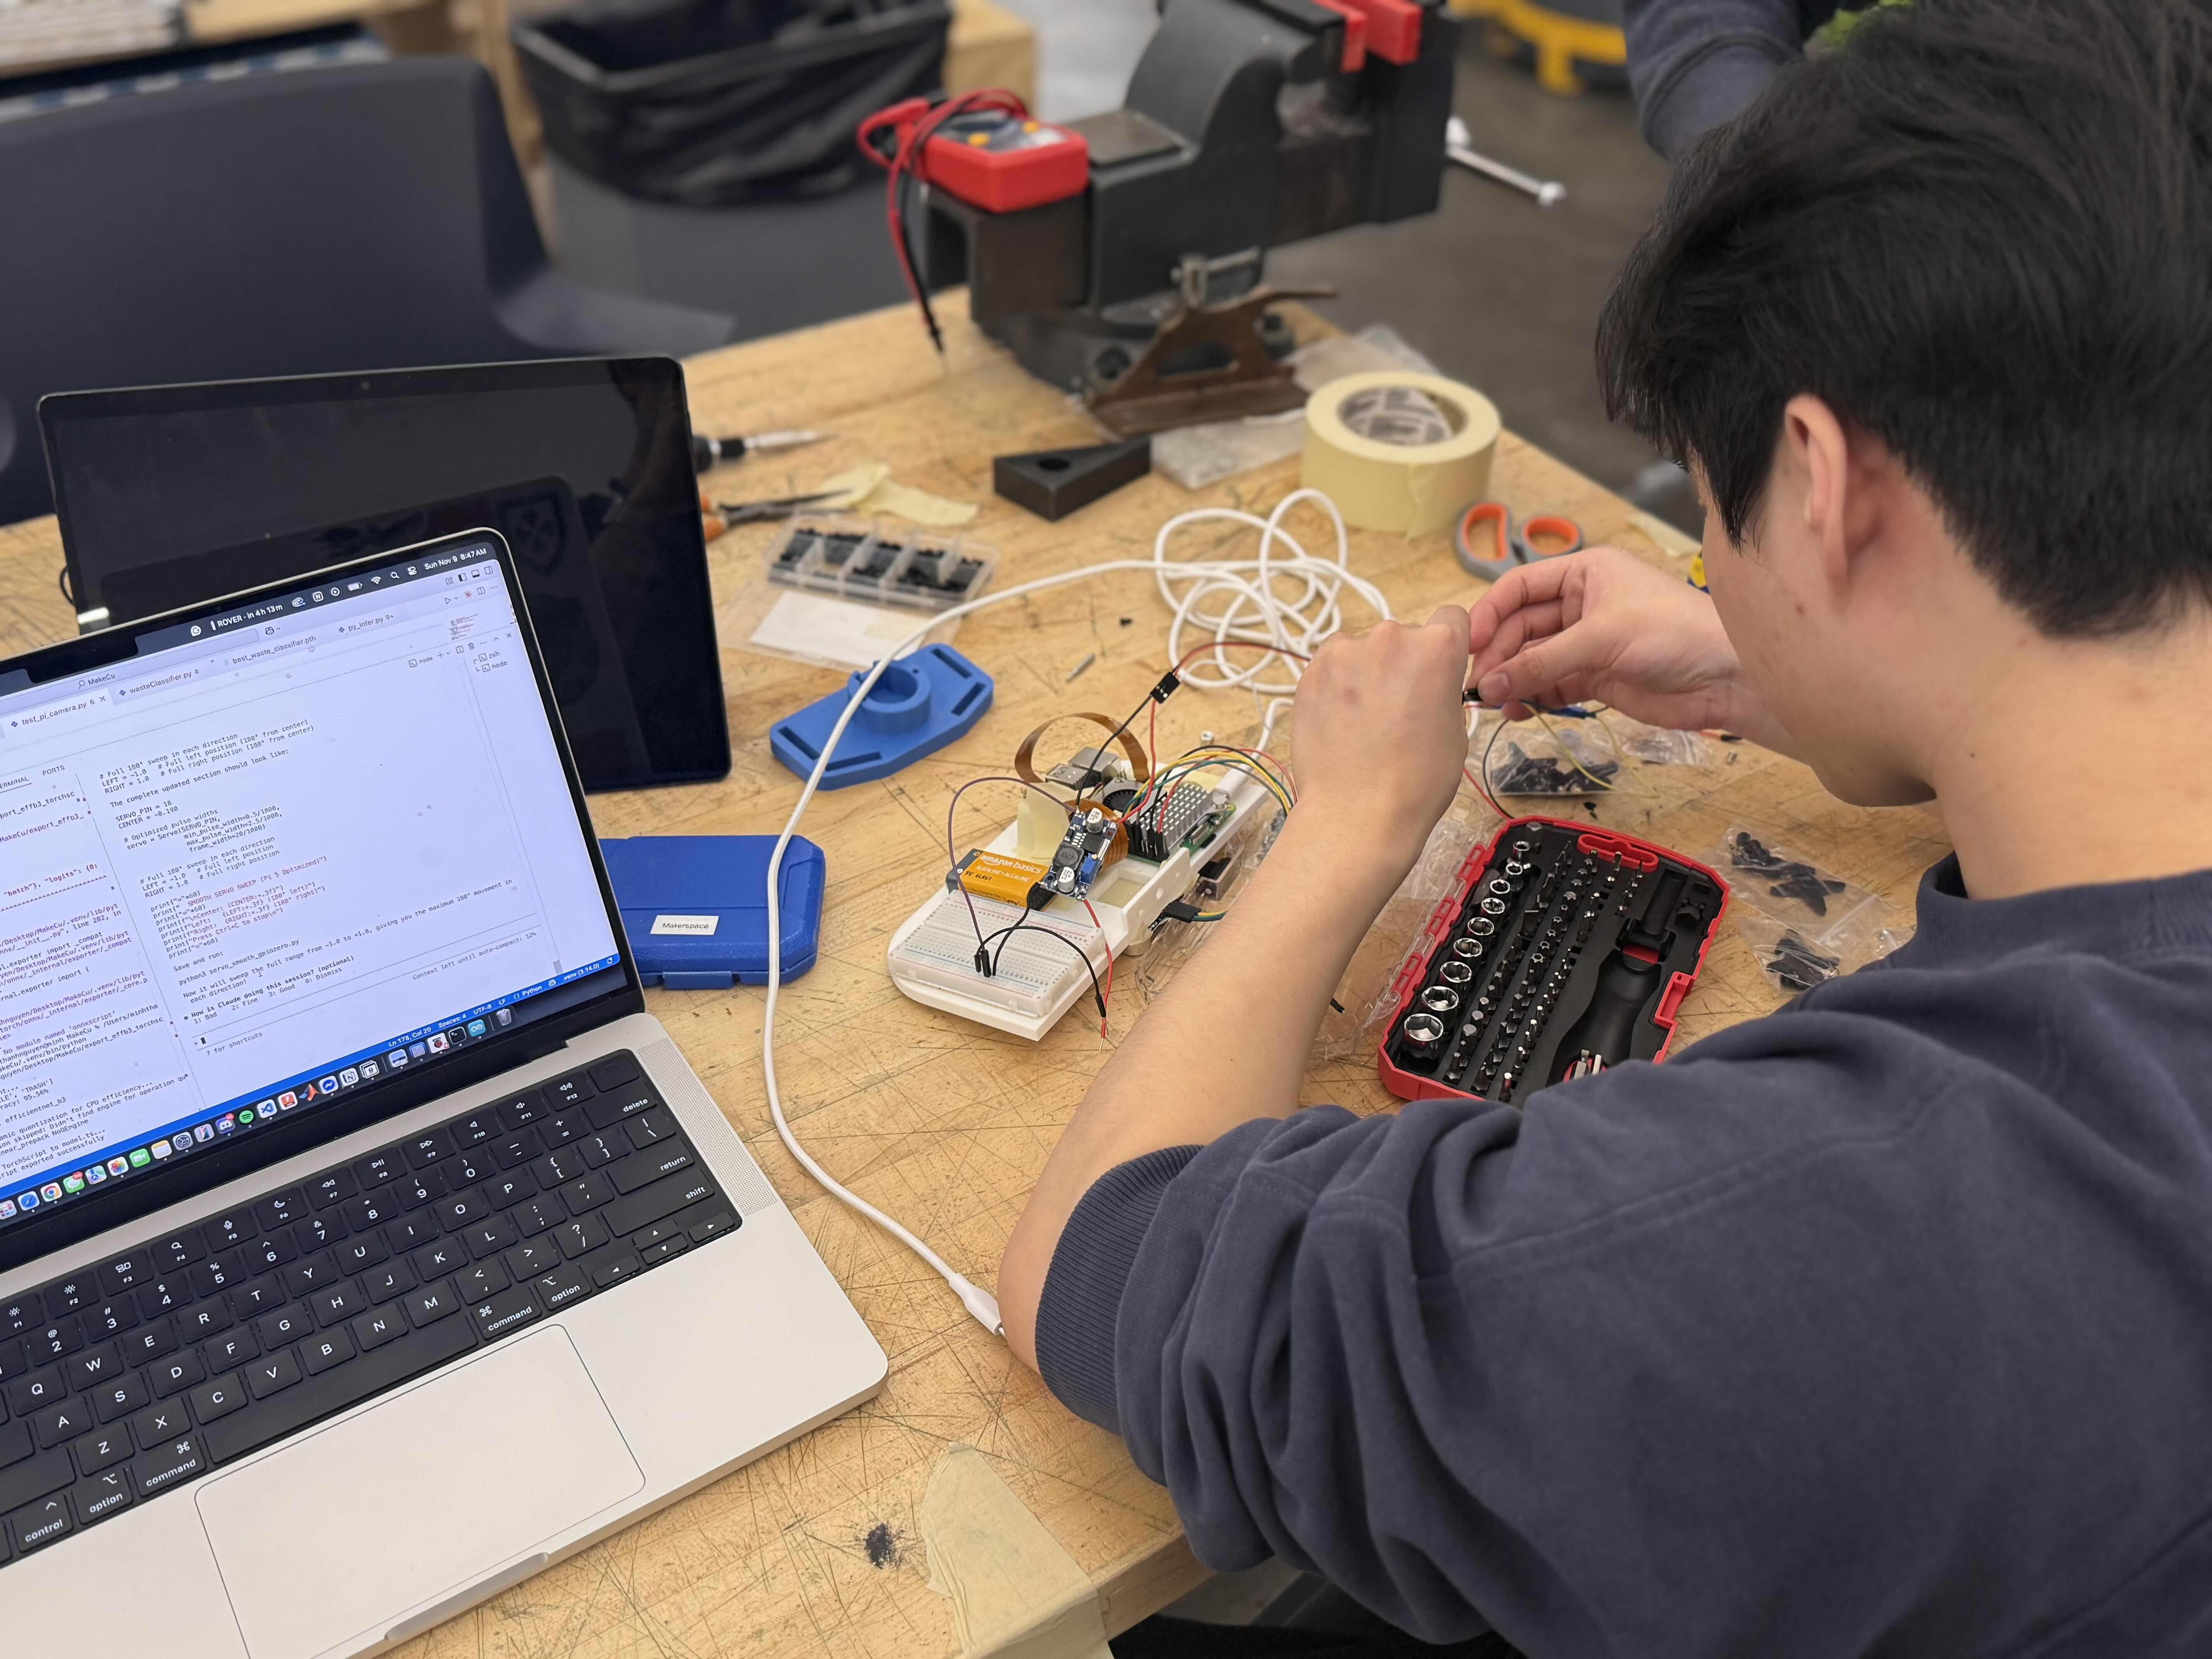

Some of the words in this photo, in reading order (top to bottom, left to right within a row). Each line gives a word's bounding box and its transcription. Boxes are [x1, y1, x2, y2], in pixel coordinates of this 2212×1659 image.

[217, 615, 242, 627] ROVER
[348, 617, 383, 631] py_infer.py
[88, 674, 115, 685] MakeCu
[202, 734, 237, 748] direction
[42, 765, 65, 775] PORTS
[127, 790, 158, 802] complete
[162, 778, 189, 791] updated
[193, 770, 221, 782] section
[224, 761, 247, 772] should
[251, 756, 266, 764] look
[270, 749, 288, 757] like:
[980, 854, 1012, 867] amazon
[1013, 862, 1042, 874] basics
[210, 979, 226, 988] will
[229, 972, 248, 982] sweep
[267, 959, 282, 968] full
[285, 953, 304, 961] range
[376, 920, 397, 931] giving
[429, 900, 452, 911] maximum
[474, 884, 498, 895] movement
[179, 971, 206, 985] python3
[209, 939, 299, 974] servo_smooth_gpiozero.py
[413, 968, 438, 979] Context
[458, 953, 476, 963] until
[479, 937, 522, 956] auto-compact:
[173, 963, 189, 972] Save
[218, 997, 240, 1007] Claude
[244, 989, 263, 998] doing
[285, 969, 313, 984] session?
[318, 955, 353, 972] (optional)
[242, 998, 258, 1006] Fine
[279, 983, 295, 993] Good
[316, 967, 342, 980] Dismiss
[190, 994, 206, 1003] each
[209, 979, 246, 996] direction!
[522, 986, 542, 996] Python
[16, 1038, 41, 1050] module
[45, 1029, 65, 1040] named
[69, 1010, 115, 1030] 'onnxscript'
[229, 1032, 262, 1047] shortcuts
[623, 1099, 647, 1112] delete
[661, 1157, 685, 1170] return
[417, 1189, 426, 1198] 9
[504, 1184, 513, 1193] P
[686, 1187, 705, 1199] shift
[369, 1210, 378, 1219] 8
[455, 1205, 465, 1214] O
[317, 1230, 325, 1239] 7
[409, 1226, 413, 1235] I
[485, 1232, 495, 1241] L
[267, 1252, 276, 1261] 6
[355, 1247, 365, 1257] U
[435, 1252, 446, 1263] K
[215, 1273, 224, 1283] 5
[304, 1268, 312, 1278] Y
[386, 1275, 393, 1285] J
[251, 1290, 260, 1300] T
[551, 1284, 580, 1301] option
[163, 1295, 171, 1304] 4
[331, 1297, 343, 1308] H
[425, 1297, 438, 1309] M
[107, 1318, 117, 1328] 3
[199, 1313, 209, 1324] R
[488, 1306, 532, 1331] command
[280, 1320, 290, 1330] G
[374, 1320, 385, 1332] N
[52, 1341, 62, 1352] 2
[145, 1336, 155, 1347] E
[227, 1343, 235, 1354] F
[321, 1344, 332, 1355] B
[86, 1358, 100, 1371] W
[171, 1367, 182, 1378] D
[266, 1367, 276, 1378] V
[32, 1384, 43, 1395] Q
[115, 1391, 125, 1402] S
[213, 1392, 223, 1403] C
[59, 1416, 69, 1428] A
[156, 1416, 167, 1429] X
[99, 1441, 110, 1454] Z
[146, 1459, 197, 1488] command
[90, 1494, 124, 1514] option
[26, 1519, 64, 1543] control
